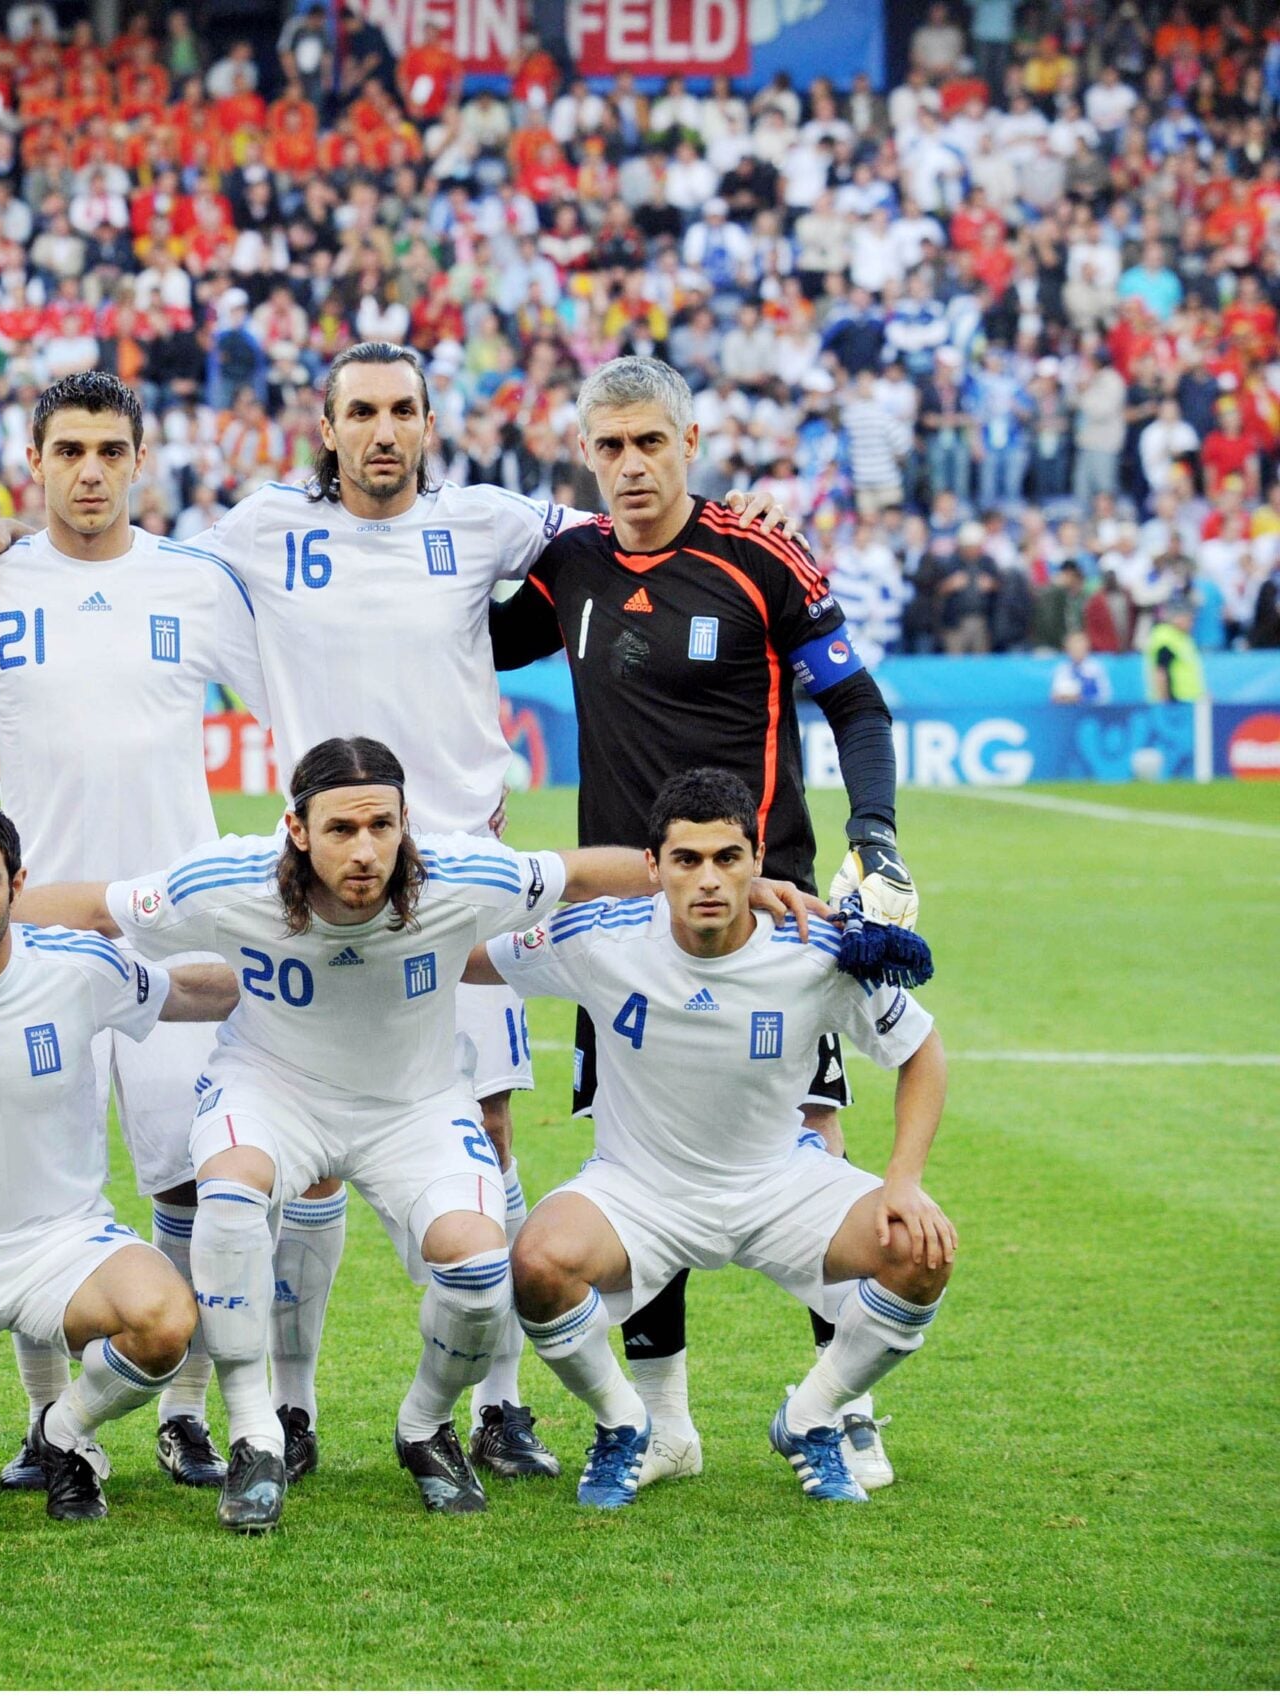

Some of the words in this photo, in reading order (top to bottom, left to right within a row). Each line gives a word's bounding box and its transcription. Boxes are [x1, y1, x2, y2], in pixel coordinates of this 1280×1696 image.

[565, 0, 741, 62] FELD
[356, 523, 391, 532] adidas
[284, 528, 333, 592] 16
[78, 603, 112, 612] adidas
[578, 598, 593, 659] 1
[240, 947, 313, 1007] 20
[328, 956, 365, 967] adidas
[612, 992, 648, 1049] 4
[683, 1000, 720, 1011] adidas
[451, 1118, 500, 1169] 2
